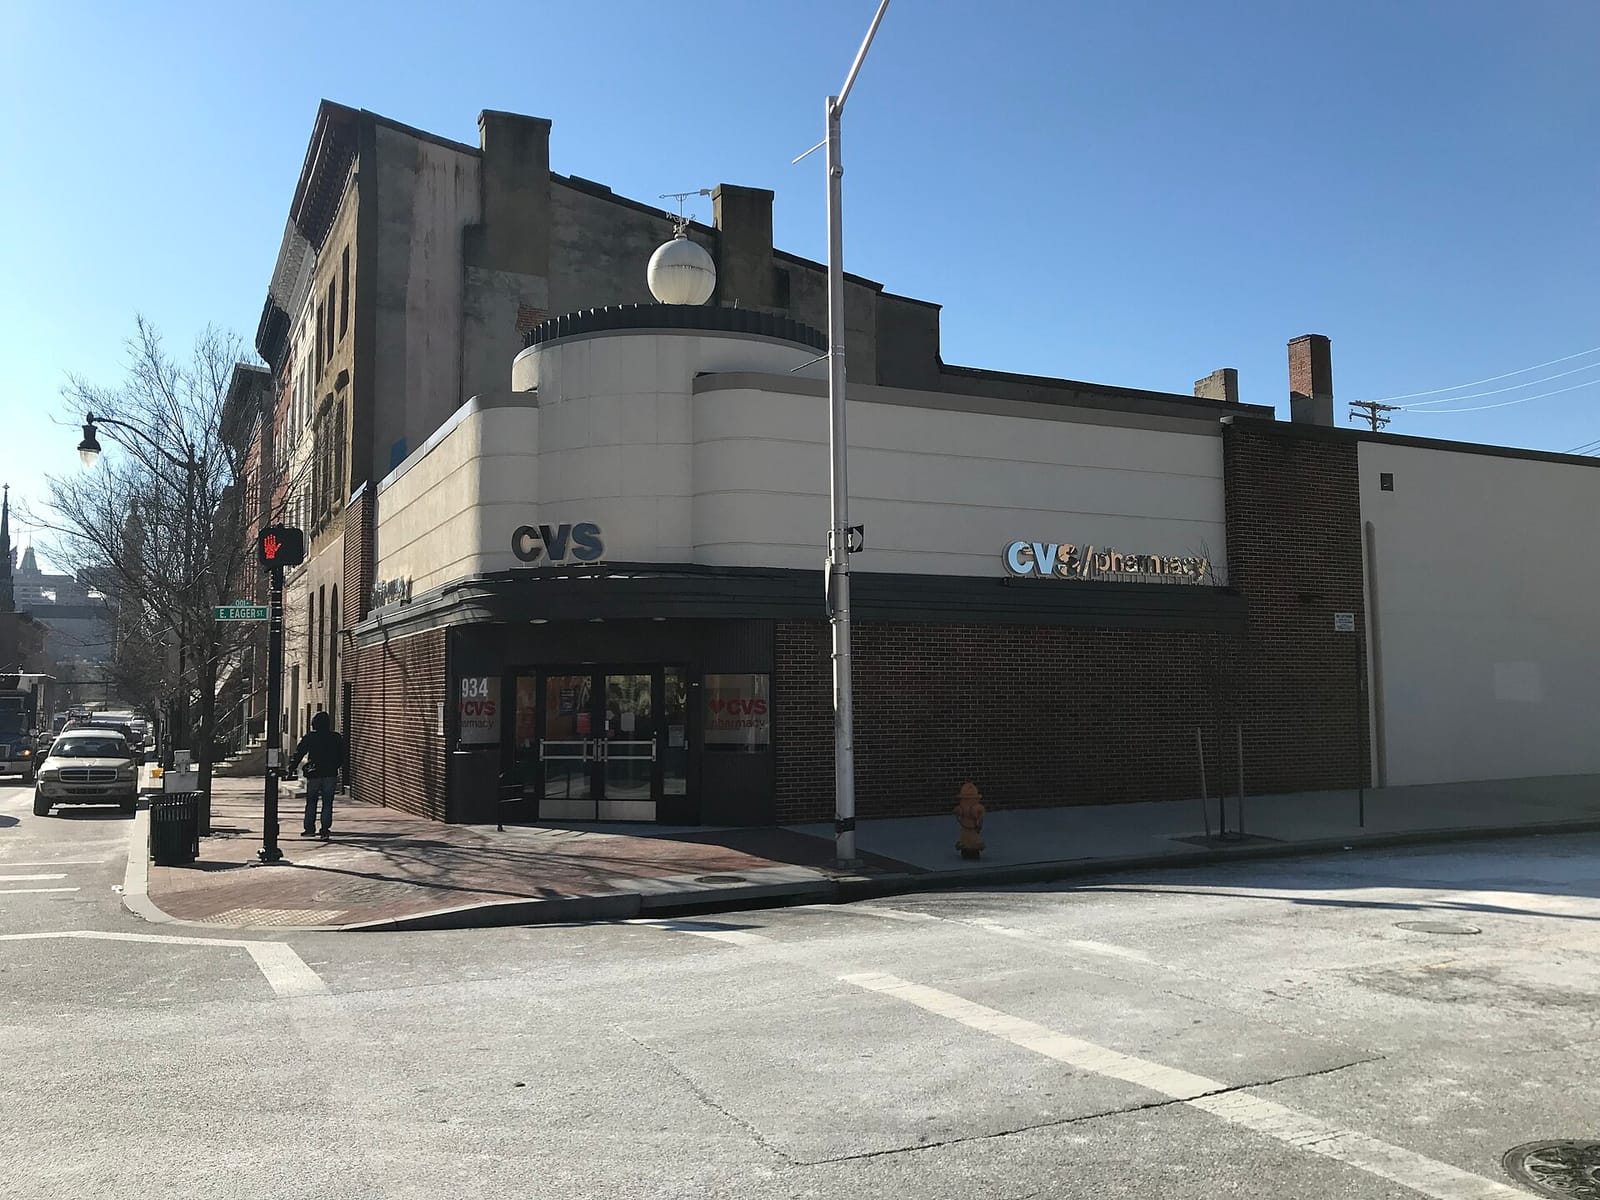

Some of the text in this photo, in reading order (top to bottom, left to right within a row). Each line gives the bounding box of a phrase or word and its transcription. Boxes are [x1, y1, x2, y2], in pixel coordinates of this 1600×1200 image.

[511, 522, 604, 562] CVS
[219, 608, 227, 619] E.
[229, 608, 256, 619] EAGER
[461, 677, 489, 698] 934
[464, 701, 497, 716] CVS
[726, 698, 768, 716] CVS
